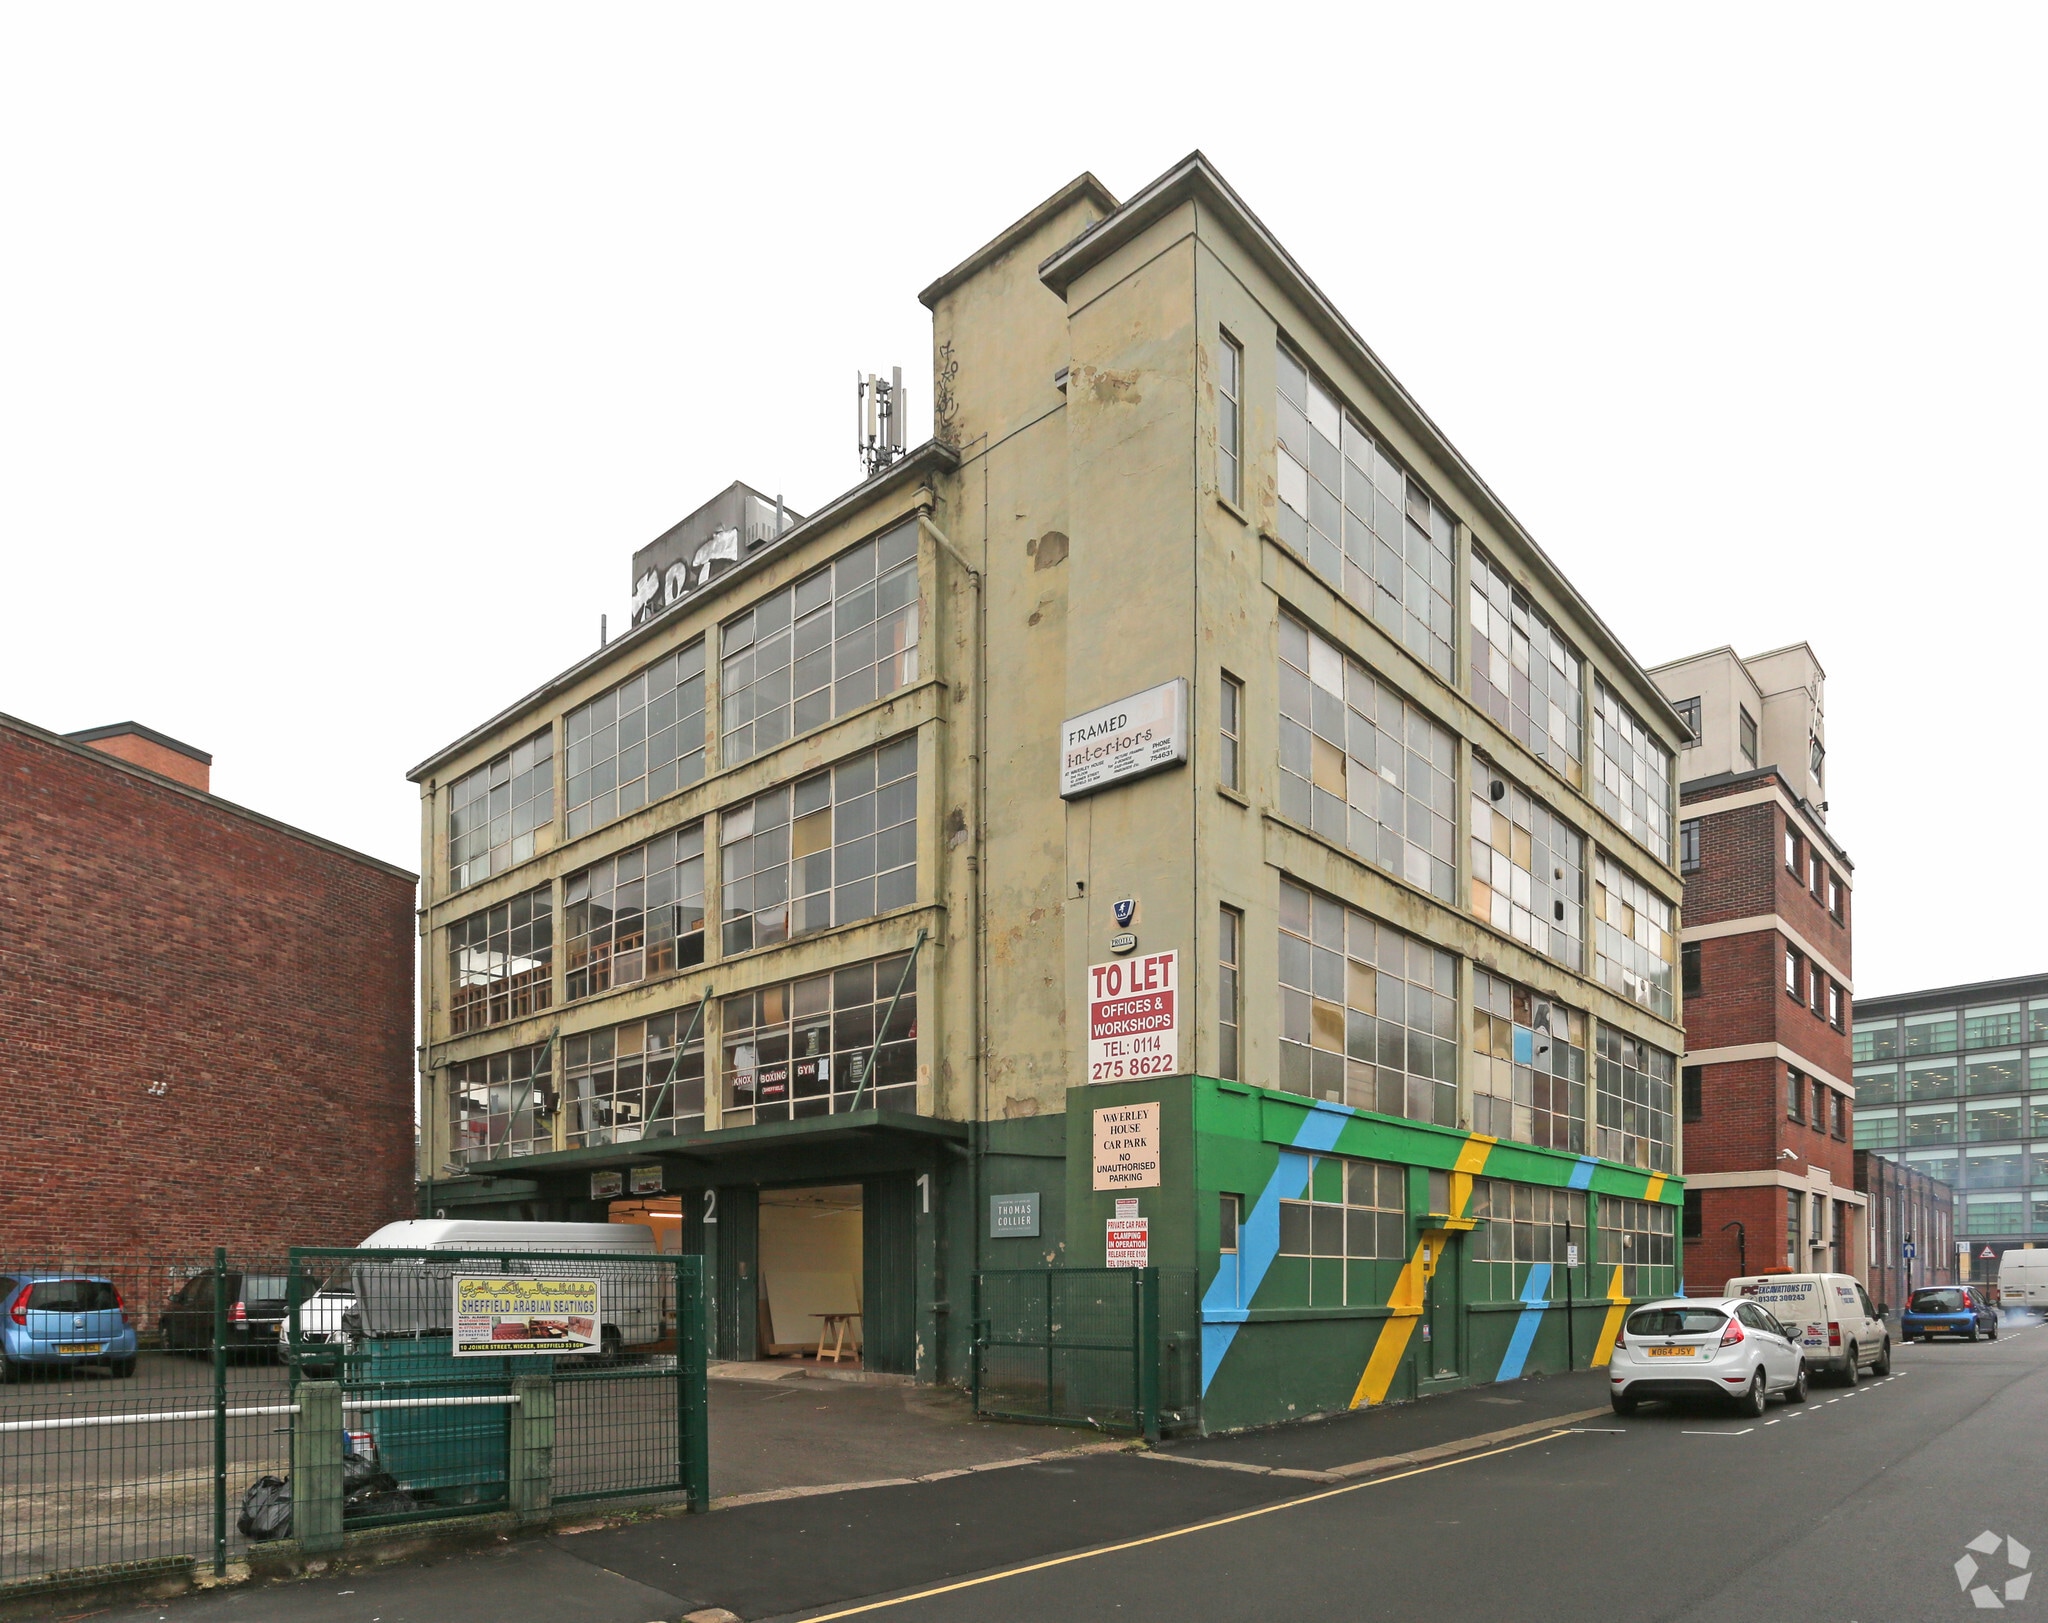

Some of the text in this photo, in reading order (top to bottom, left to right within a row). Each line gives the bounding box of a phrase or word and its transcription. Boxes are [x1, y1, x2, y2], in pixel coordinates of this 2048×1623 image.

[1069, 713, 1128, 746] FRAMED
[1067, 729, 1153, 768] i-n-t-e-r-i-o-r-s
[1152, 737, 1171, 749] PHONE
[1150, 749, 1174, 762] 754631
[1090, 759, 1104, 768] HOUSE
[1092, 954, 1173, 998] TO LET
[1101, 996, 1163, 1018] OFFICES &
[1094, 1013, 1171, 1036] WORKSHOPS
[1103, 1035, 1161, 1057] TEL: 0114
[1092, 1054, 1173, 1080] 275 8622
[733, 1063, 815, 1086] KNOX BOXING GYM
[1102, 1109, 1149, 1123] WAVERLEY
[1110, 1123, 1141, 1135] HOUSE
[1103, 1137, 1147, 1150] CAR PARK
[1119, 1153, 1131, 1161] NO
[1096, 1161, 1156, 1173] UNAUTHORISED
[1109, 1172, 1143, 1182] PARKING
[916, 1173, 930, 1213] 1
[703, 1189, 717, 1223] 2
[998, 1204, 1031, 1215] THOMAS
[998, 1216, 1031, 1226] COLLIER
[1107, 1220, 1147, 1229] PRIVATE CAR PARK
[1108, 1240, 1146, 1248] IN OPERATION
[1759, 1284, 1800, 1294] EXCAVATIONS
[1800, 1283, 1812, 1292] LTD
[1758, 1295, 1778, 1303] 01302
[462, 1300, 594, 1313] SHEFFIELD ARABIAN SEATINGS
[1675, 1347, 1691, 1355] JSY
